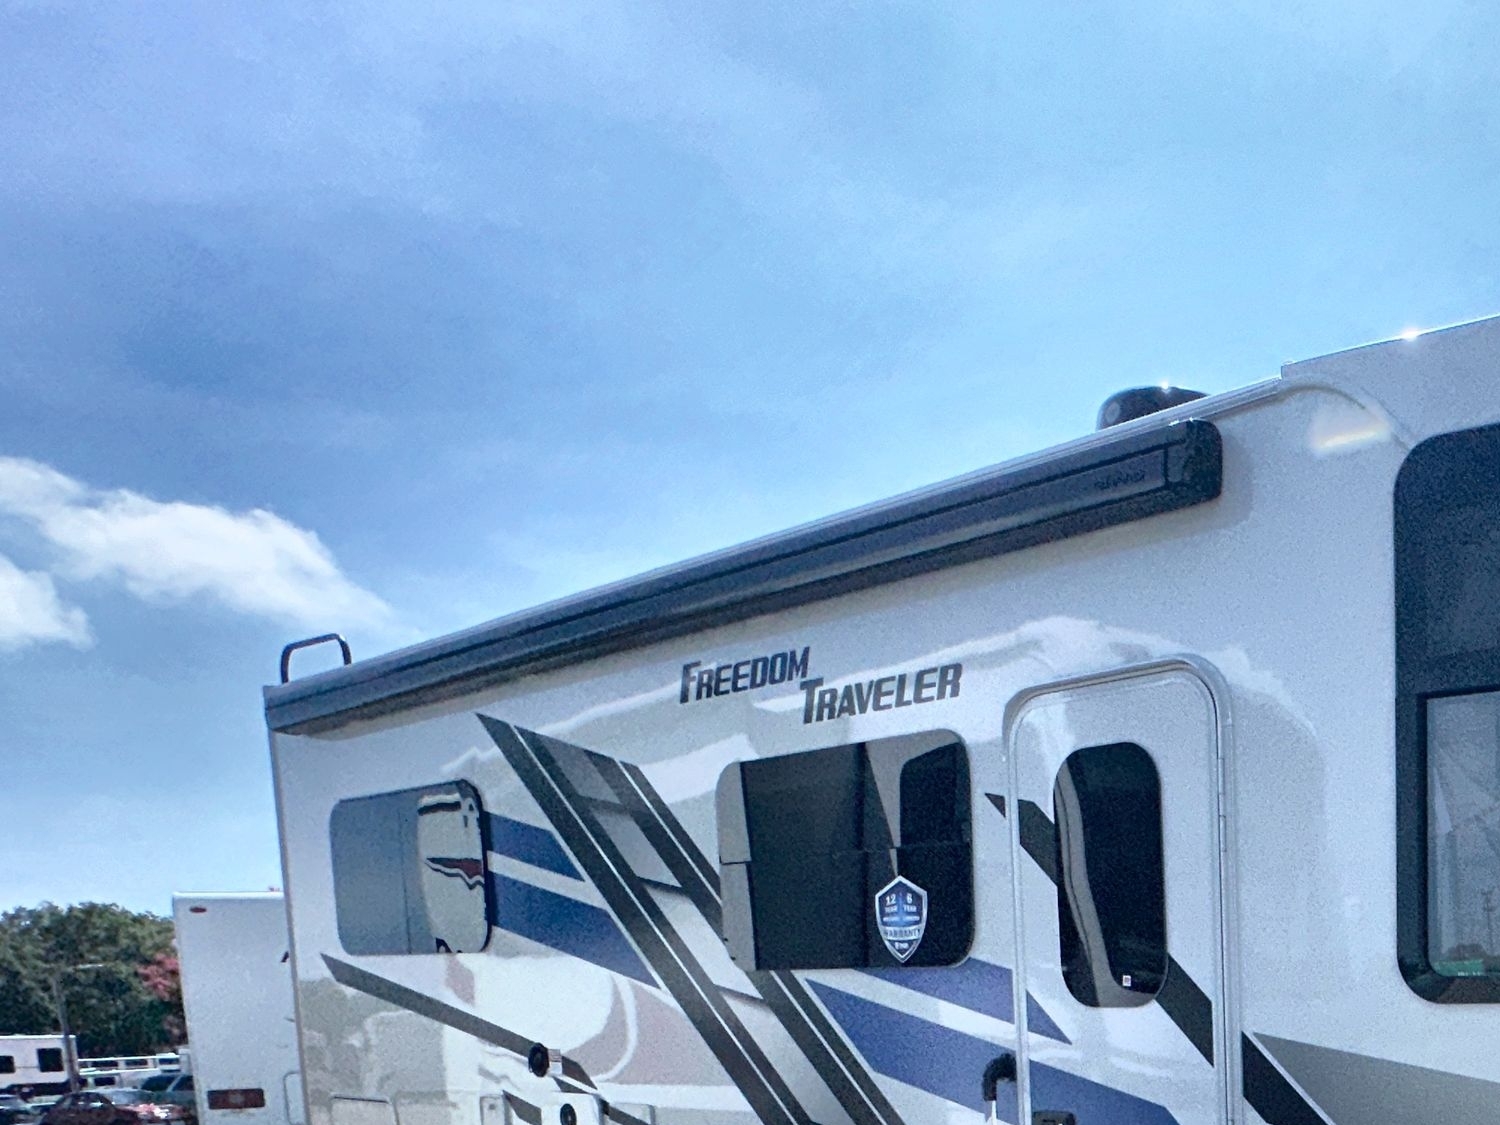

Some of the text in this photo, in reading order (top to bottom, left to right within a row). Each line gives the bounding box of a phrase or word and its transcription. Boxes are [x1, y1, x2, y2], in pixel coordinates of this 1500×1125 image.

[680, 647, 810, 704] FREEDOM
[800, 663, 963, 724] TRAVELER
[885, 893, 897, 905] 12
